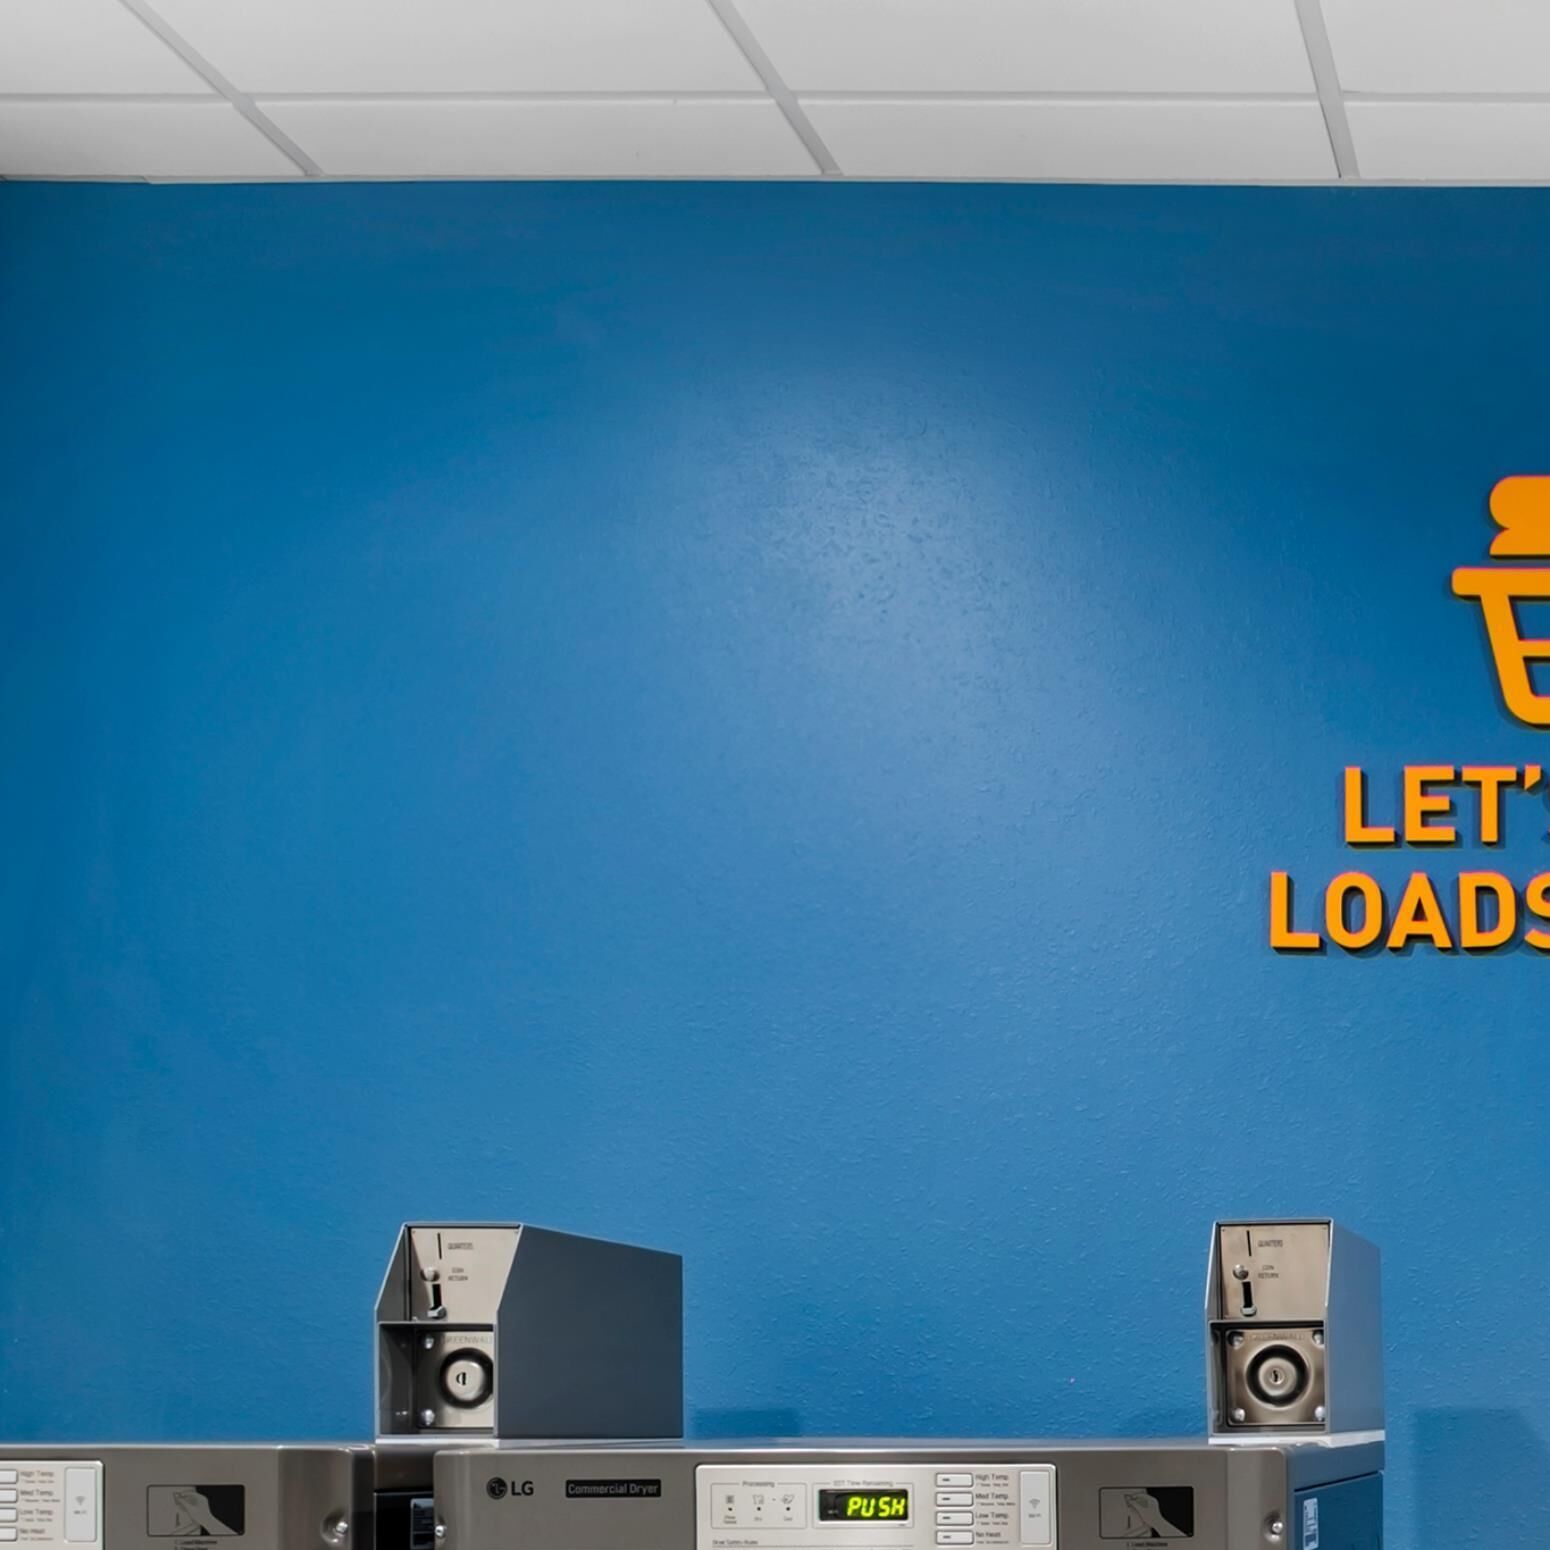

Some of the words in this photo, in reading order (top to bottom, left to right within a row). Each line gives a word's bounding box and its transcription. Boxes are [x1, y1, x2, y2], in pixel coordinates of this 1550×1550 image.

[511, 1481, 534, 1496] LG
[568, 1483, 627, 1495] Commercial
[629, 1483, 658, 1496] Dryer
[846, 1496, 905, 1518] PUSH
